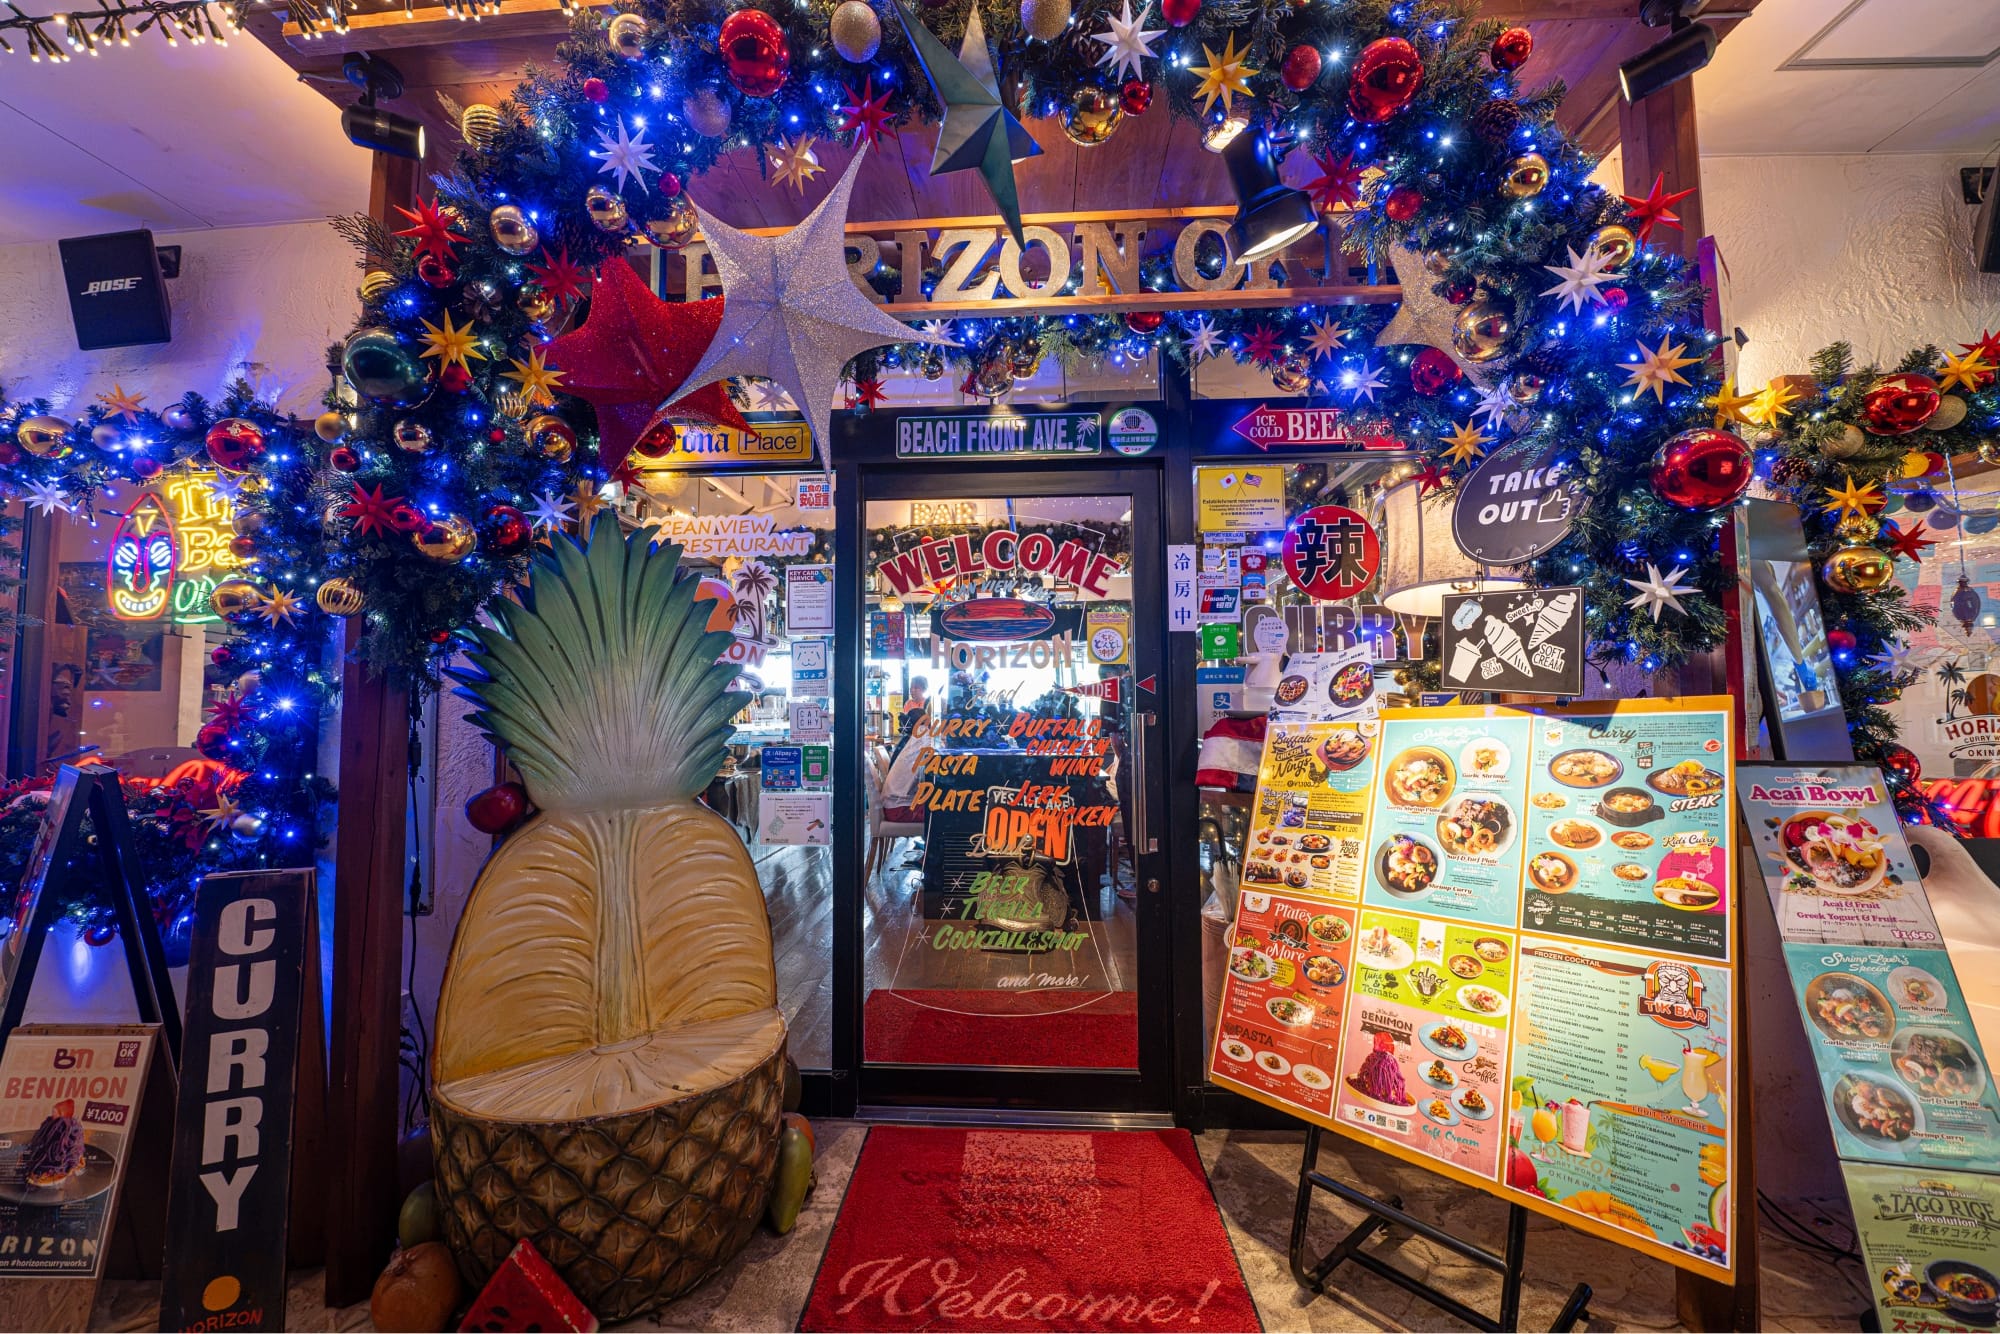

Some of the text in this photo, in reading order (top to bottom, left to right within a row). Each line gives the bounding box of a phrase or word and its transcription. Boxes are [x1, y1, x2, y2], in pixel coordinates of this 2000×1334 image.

[679, 221, 1148, 304] HRIZON
[81, 276, 141, 295] BOSE
[1256, 415, 1276, 426] ICE
[900, 418, 1073, 454] BEACH FRONT AVE.
[1250, 426, 1283, 438] COLD
[671, 431, 797, 454] rona Place
[1489, 466, 1562, 496] TAKE
[911, 502, 978, 525] BAR
[1478, 499, 1537, 526] OUT
[720, 519, 769, 535] VIEW
[177, 526, 258, 573] Ba
[681, 536, 809, 554] RESTAURANT
[1295, 517, 1369, 587] 辣
[877, 530, 1121, 598] WELCOME
[981, 579, 1018, 593] VIEW
[1174, 552, 1191, 626] 冷房中
[1204, 594, 1236, 602] UnionPay
[931, 629, 1072, 670] HORIZON
[1539, 644, 1563, 659] SOFT
[1482, 658, 1497, 670] SOFT
[1482, 664, 1503, 678] CREAM
[1533, 654, 1564, 672] CREAM
[794, 671, 825, 679] ほじょ犬
[1076, 682, 1112, 700] SLIDE
[911, 713, 990, 739] CURRY
[1008, 712, 1101, 739] BUFFALO
[1026, 738, 1111, 757] CHICKEN
[1964, 735, 1991, 744] CURRY
[911, 746, 979, 777] PASTA
[1050, 757, 1102, 777] WING
[910, 782, 986, 813] PLATE
[1011, 780, 1071, 806] JERK
[1751, 785, 1878, 802] Acai Bowl
[1669, 794, 1722, 813] STEAK
[1030, 805, 1119, 827] CHICKEN
[986, 807, 1069, 860] OPEN
[1688, 834, 1716, 847] Curry
[969, 871, 1030, 895] BEER
[960, 897, 1043, 920] TEQUILA
[1274, 902, 1313, 922] Plates
[1854, 901, 1880, 909] Fruit
[1797, 911, 1825, 920] Greek
[1827, 913, 1859, 923] Yogurt
[1872, 915, 1897, 923] Fruit
[1892, 929, 1935, 941] ¥1,650
[1265, 943, 1305, 962] More
[1534, 950, 1602, 968] FROZEN COCKTAIL
[1821, 952, 1868, 967] Shrimp
[1849, 963, 1890, 973] Special
[997, 972, 1031, 988] and
[1362, 983, 1399, 1000] Tomato
[1361, 1010, 1413, 1032] BENIMON
[1674, 1005, 1707, 1023] BAR
[1236, 1026, 1275, 1047] PASTA
[119, 1049, 135, 1058] OK
[199, 898, 278, 1233] CURRY
[1462, 1062, 1499, 1084] Croffle
[5, 1076, 128, 1099] BENIMON
[86, 1108, 124, 1122] ¥1,000
[1632, 1105, 1708, 1132] FRUIT SMOOTHIE
[1445, 1130, 1480, 1147] Cream
[1911, 1131, 1964, 1142] Shrimp Curry
[1548, 1169, 1597, 1191] OKINAWA
[1890, 1193, 2000, 1224] TACO RICE
[1915, 1212, 1978, 1228] Revolution!
[1908, 1223, 1992, 1242] 進化系タコライス
[11, 1259, 87, 1268] #horizoncurryworks
[836, 1254, 1222, 1325] Welcome!
